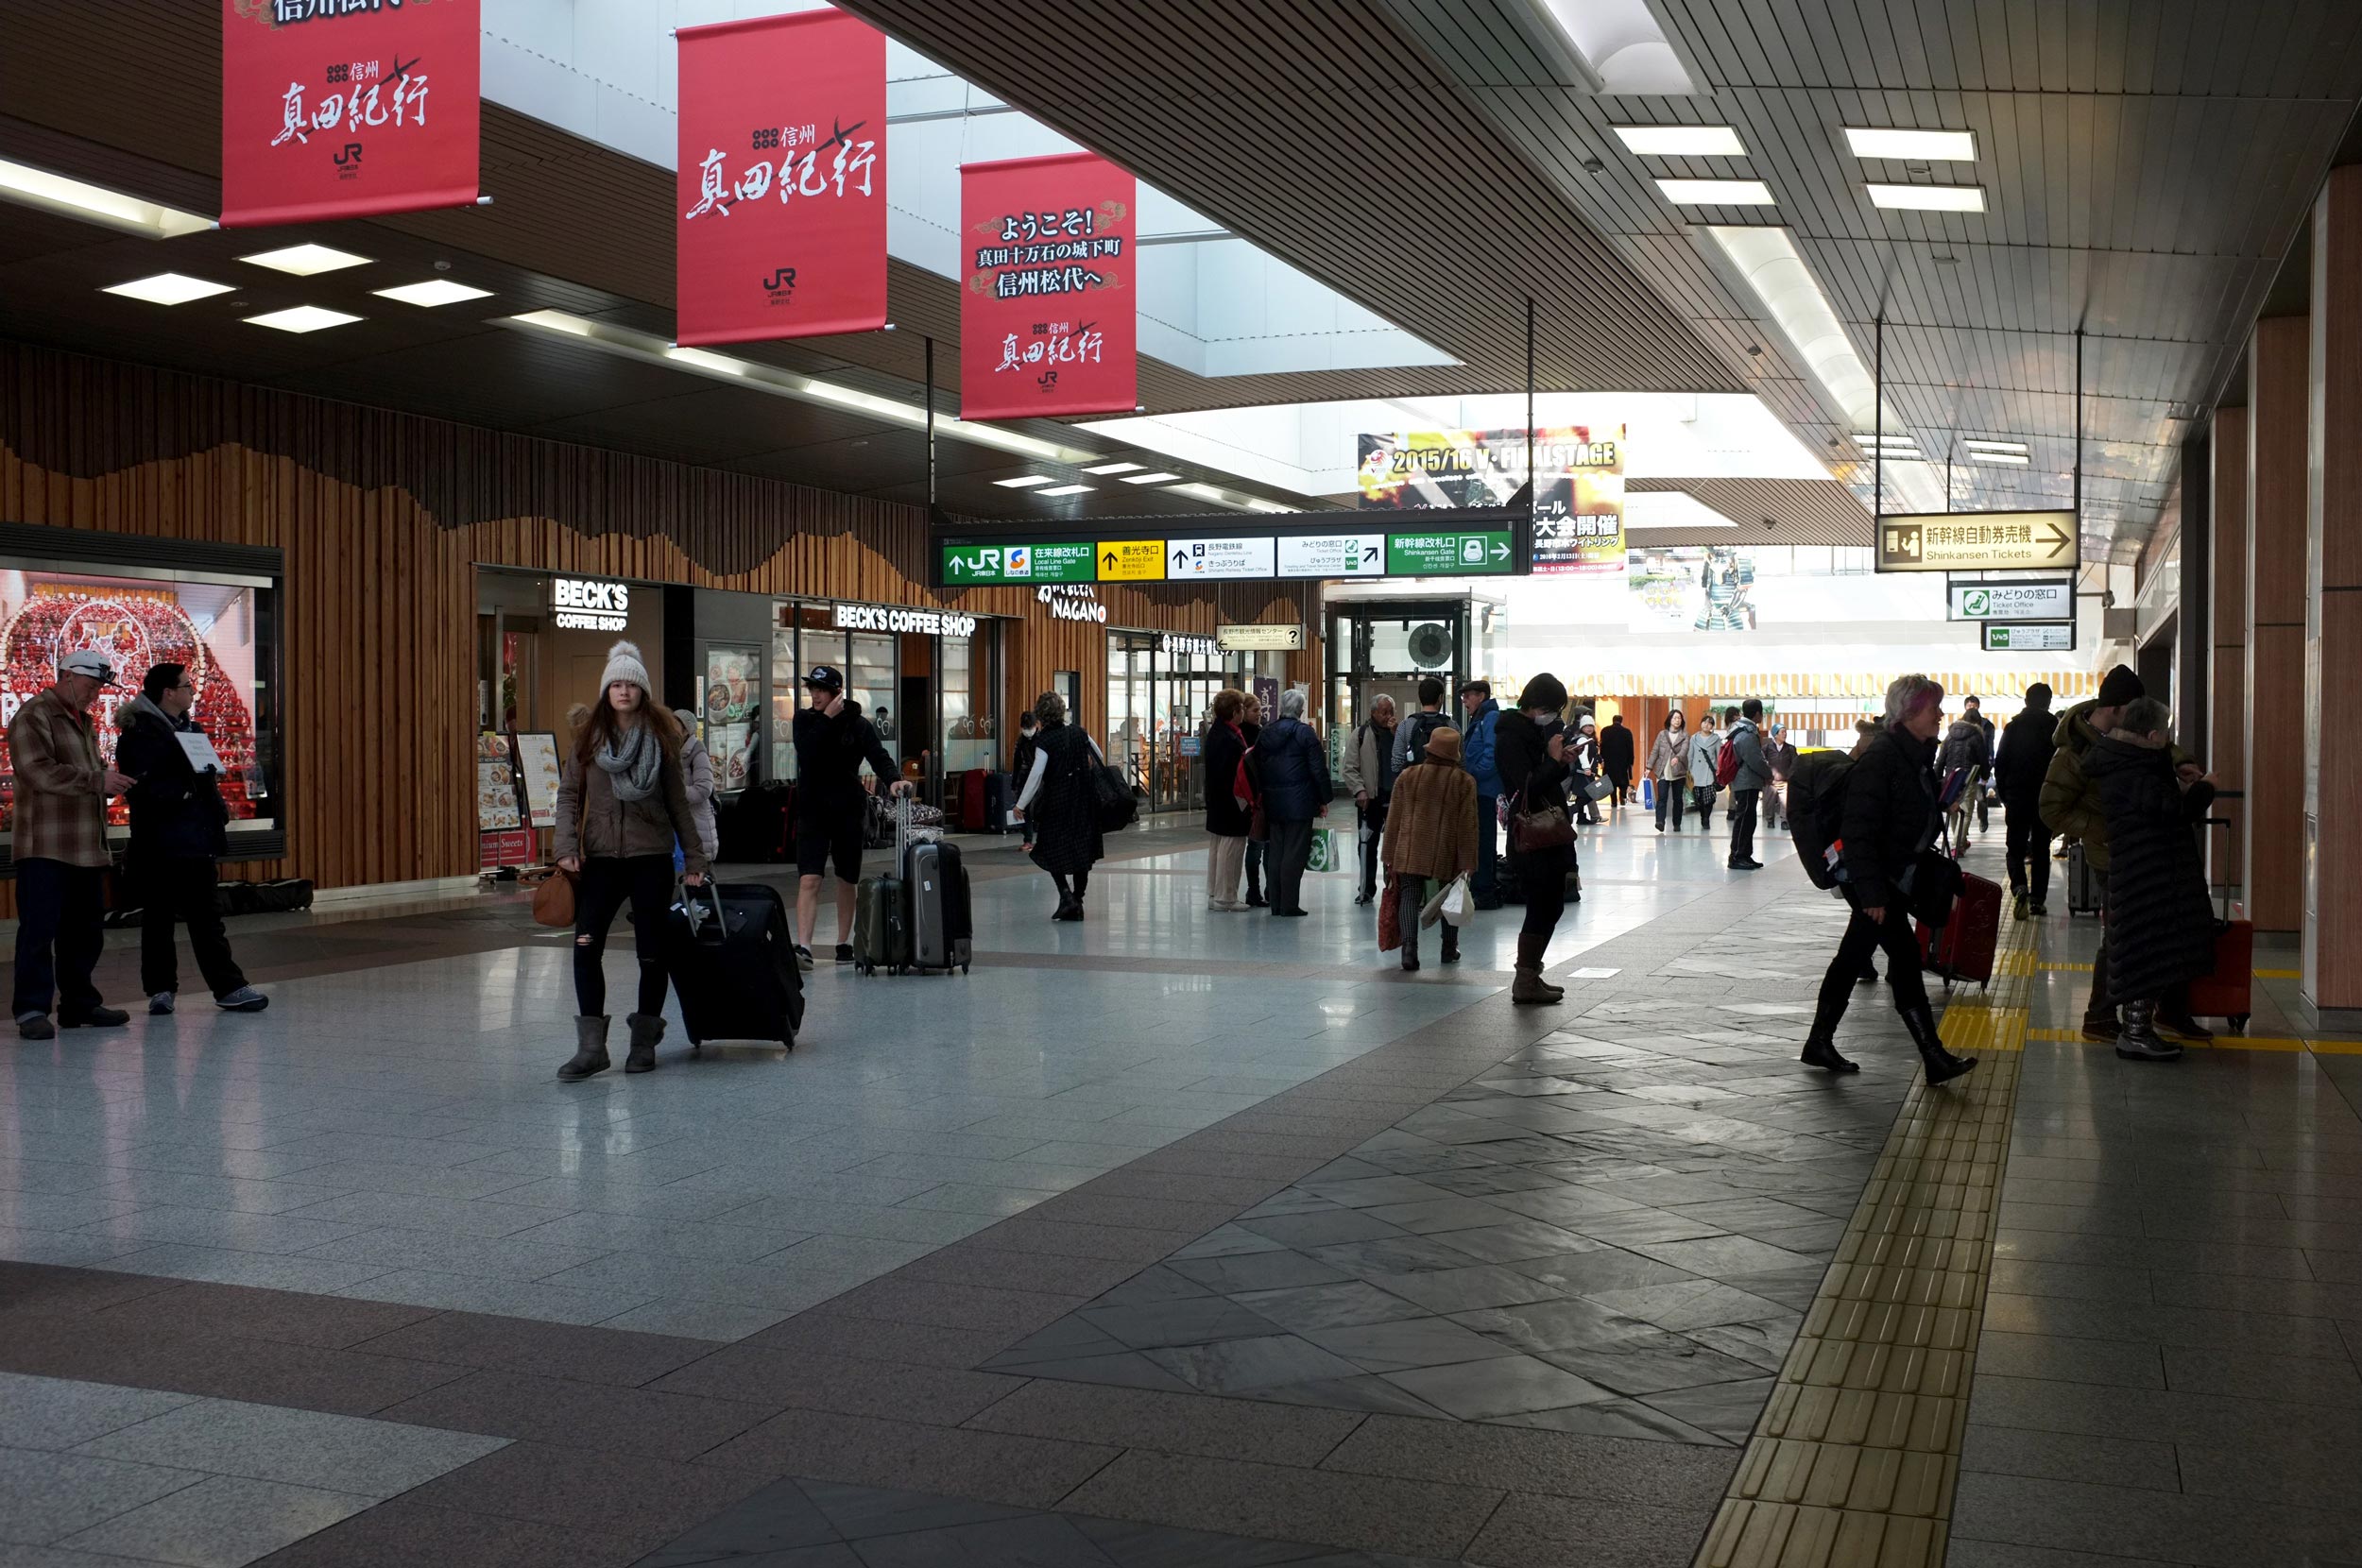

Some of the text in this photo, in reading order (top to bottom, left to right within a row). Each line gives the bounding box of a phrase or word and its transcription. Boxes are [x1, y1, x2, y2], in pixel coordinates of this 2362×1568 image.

[350, 60, 379, 81] 信州
[270, 74, 429, 146] 真田紀行
[780, 124, 815, 147] 信州
[334, 144, 363, 165] JR
[685, 139, 877, 219] 真田紀行
[977, 239, 1121, 267] 真田十万石の城下町
[762, 267, 796, 290] JR
[997, 267, 1102, 297] 信州松代へ
[1049, 322, 1069, 334] 信州
[995, 332, 1103, 372] 真田紀行
[1037, 371, 1058, 383] JR
[1393, 447, 1473, 472] 2015/16
[1532, 515, 1618, 537] 大会開催
[1926, 524, 2031, 545] 新幹線自動券売機
[1035, 547, 1089, 558] 在来線改札口
[1122, 545, 1159, 555] 善光寺口
[1208, 542, 1243, 551] 長野電鉄線
[1302, 539, 1342, 548] みどりの窓口
[1395, 537, 1455, 549] 新幹線改札口
[967, 549, 1001, 570] JR
[1926, 549, 2031, 560] Shinkansen Tickets
[556, 578, 628, 610] BECK'S
[1992, 588, 2057, 600] みどりの窓口
[1053, 597, 1106, 623] NAGANO
[556, 613, 627, 631] COFFEE SHOP
[837, 605, 976, 638] BECK'S COFFEE SHOP
[1223, 627, 1283, 636] 長野市観光情報センター
[501, 838, 523, 848] Sweets
